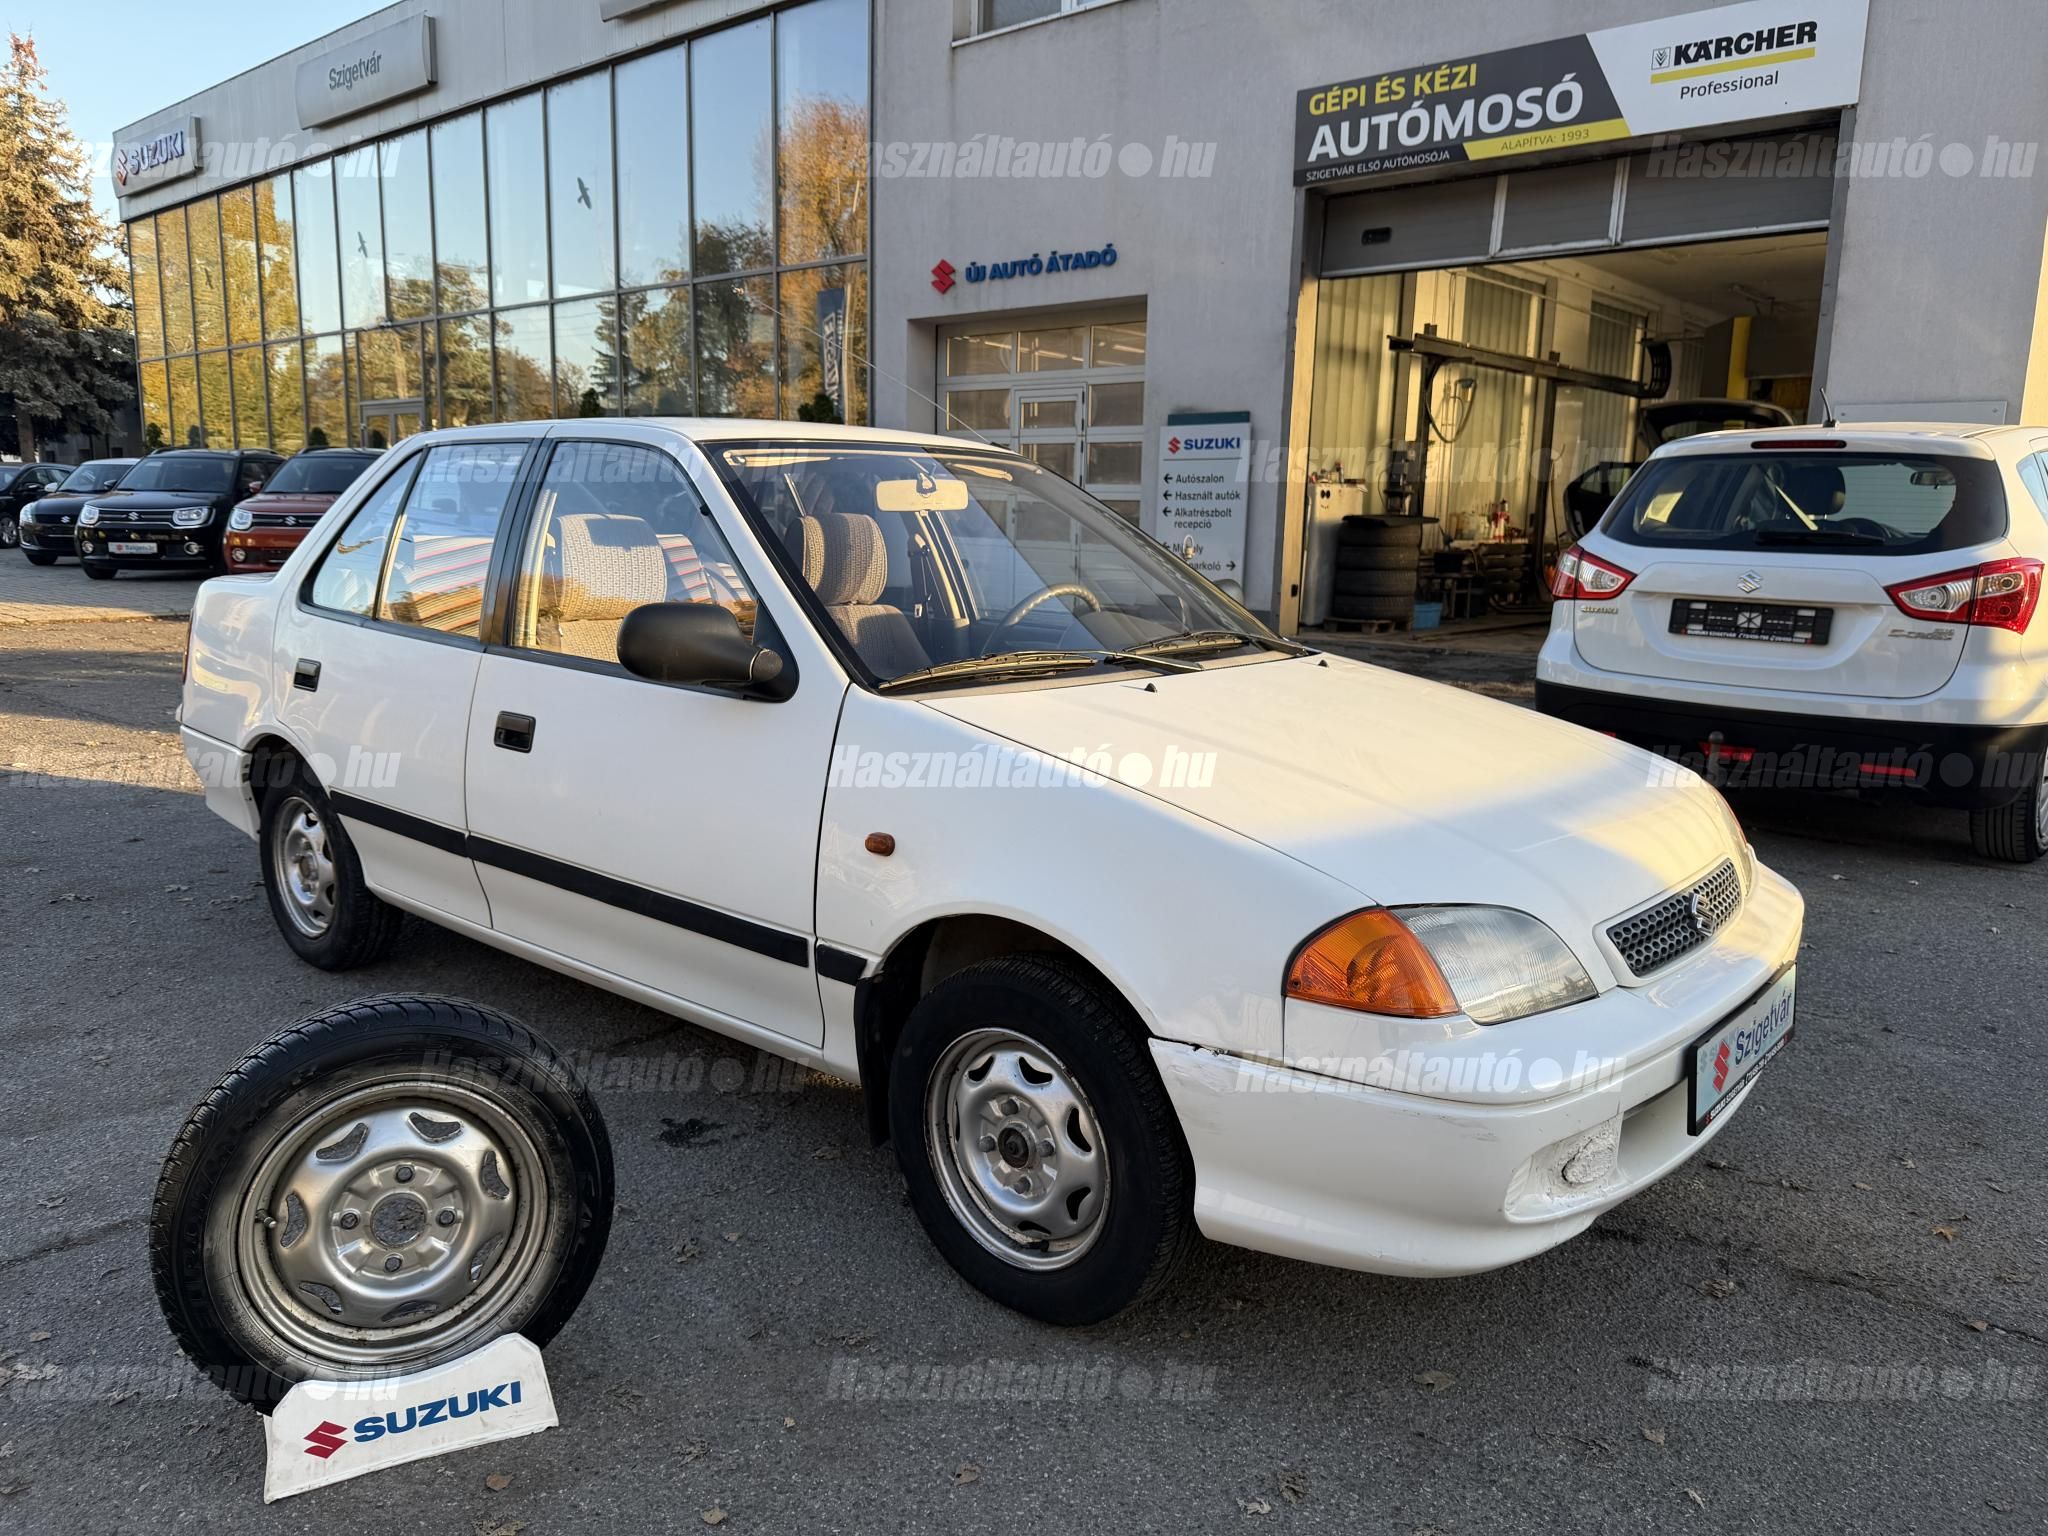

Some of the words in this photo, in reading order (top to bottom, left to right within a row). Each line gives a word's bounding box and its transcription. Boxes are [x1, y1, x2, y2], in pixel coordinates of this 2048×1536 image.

[1673, 20, 1818, 66] KÄRCHER
[328, 50, 382, 90] Szigetvár
[1679, 70, 1779, 100] Professional
[1309, 83, 1366, 117] GÉPI
[1374, 73, 1404, 105] ÉS
[1414, 62, 1478, 97] KÉZI
[1307, 73, 1585, 163] AUTÓMOSÓ
[128, 129, 185, 176] SUZUKI
[1500, 133, 1558, 153] ALAPÍTVA:
[1561, 128, 1590, 143] 1993
[1306, 164, 1355, 182] SZIGETVÁR
[965, 262, 986, 283] ÚJ
[989, 253, 1043, 281] AUTÓ
[1046, 243, 1117, 273] ÁTADÓ
[1183, 437, 1241, 451] SUZUKI
[1175, 473, 1225, 484] Autószalon
[1175, 490, 1213, 501] Használt
[1215, 490, 1241, 501] autók
[1174, 507, 1232, 519] Alkatrészbolt
[1174, 519, 1212, 530] recepció
[1735, 990, 1791, 1066] Szigetvár
[353, 1380, 523, 1443] SUZUKI
